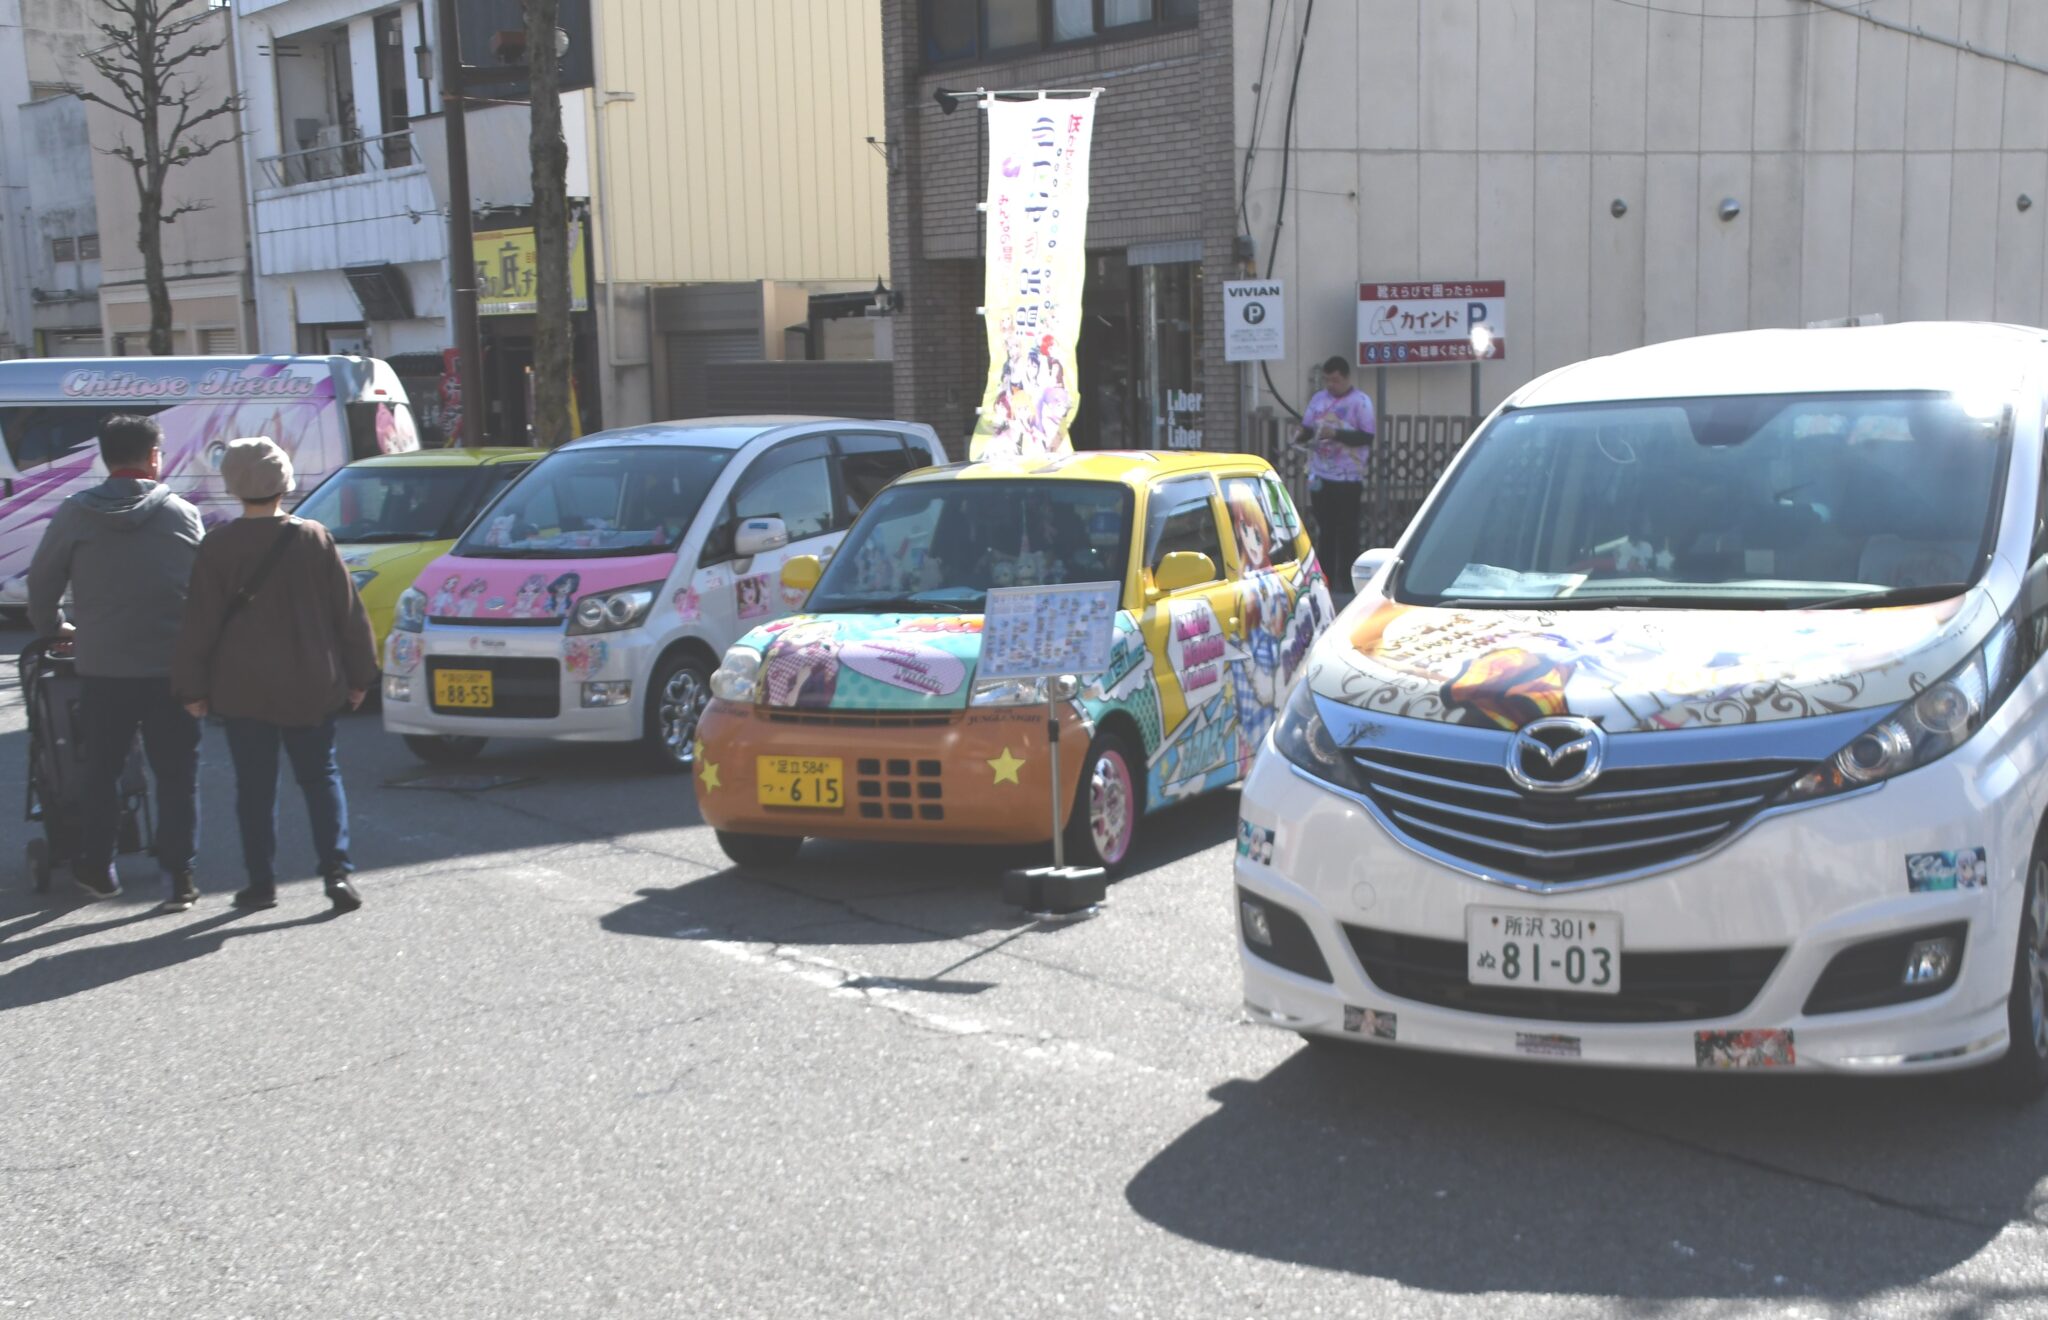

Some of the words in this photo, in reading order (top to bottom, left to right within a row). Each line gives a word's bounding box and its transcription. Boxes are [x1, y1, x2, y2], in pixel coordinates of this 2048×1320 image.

[1228, 286, 1280, 297] VIVIAN
[1248, 305, 1262, 321] P
[62, 368, 190, 397] Chitose
[198, 368, 314, 396] Ikeda
[1503, 914, 1545, 938] 所沢
[1549, 917, 1583, 940] 301
[1476, 951, 1496, 969] ぬ
[1501, 942, 1612, 986] 81-03
